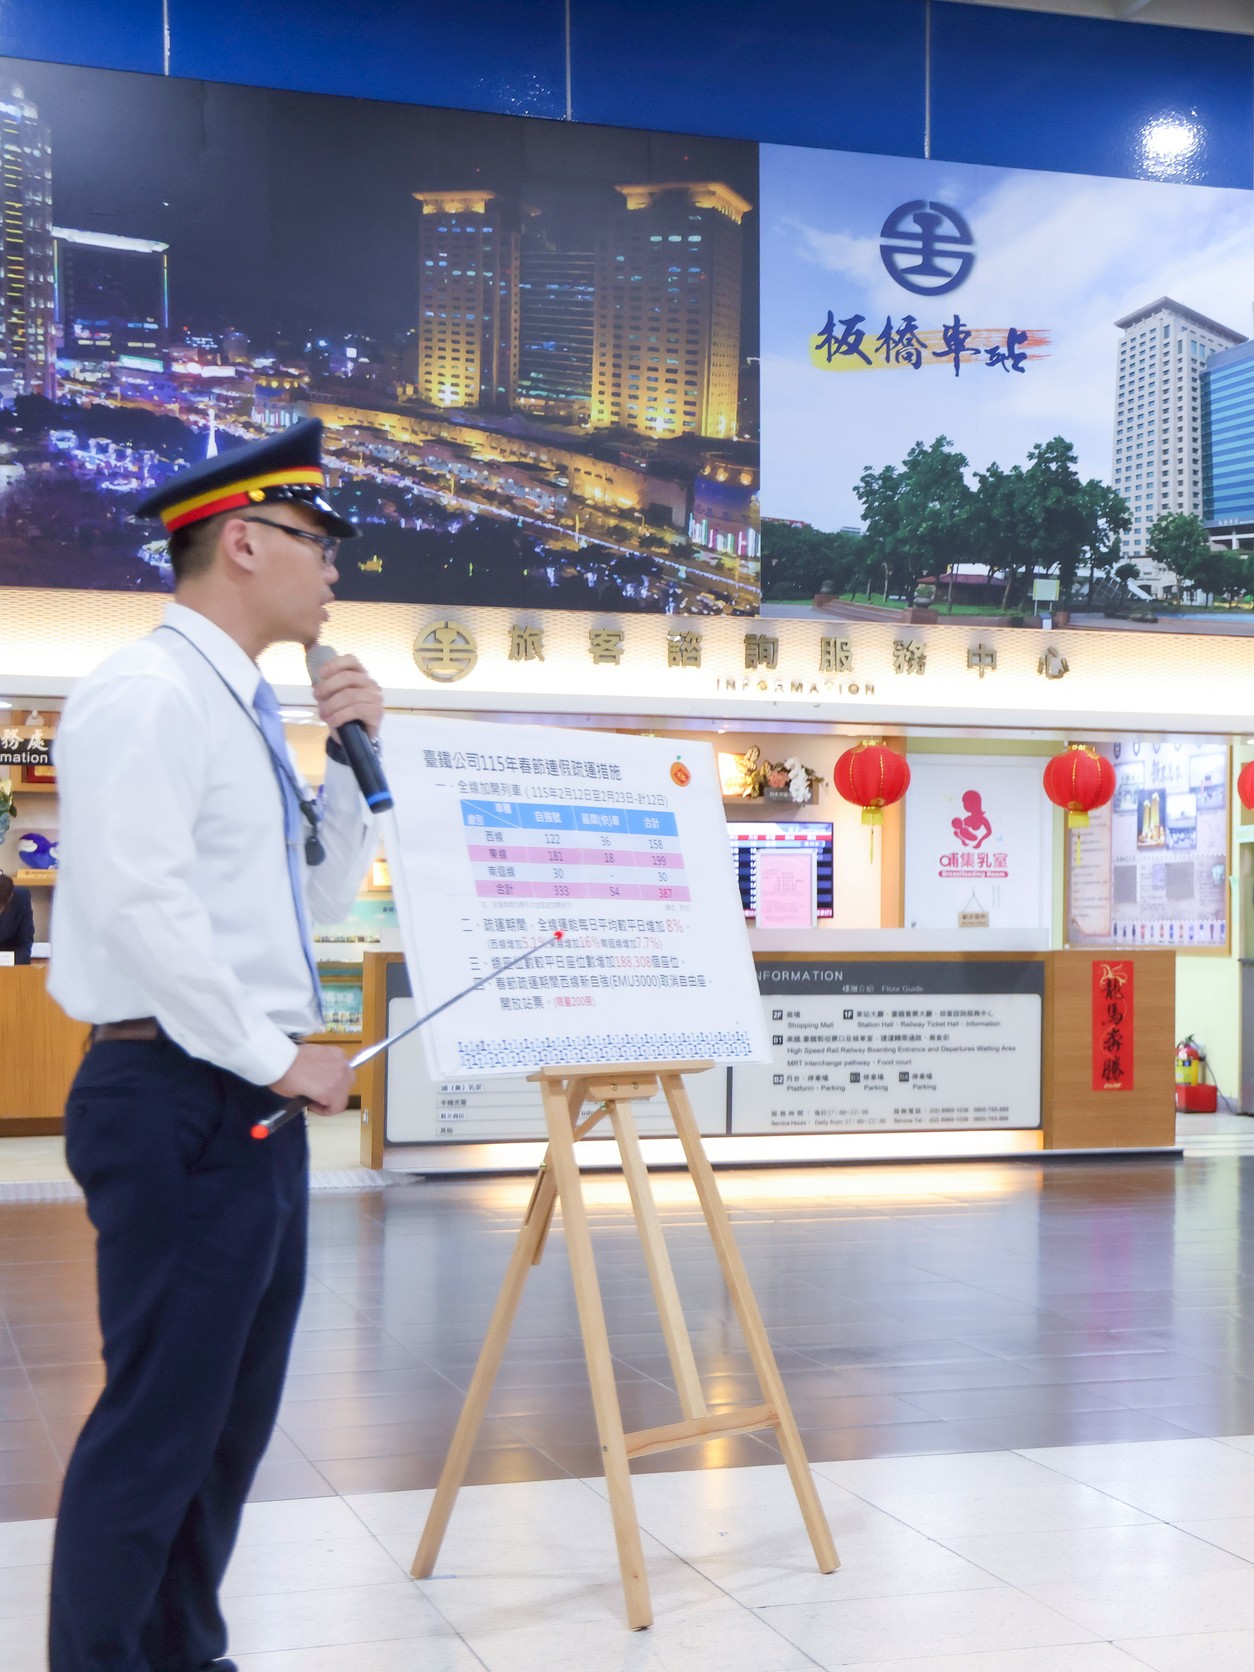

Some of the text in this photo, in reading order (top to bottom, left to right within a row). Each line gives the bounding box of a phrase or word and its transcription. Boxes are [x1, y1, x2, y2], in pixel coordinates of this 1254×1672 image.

[815, 310, 1028, 377] 板橋車站
[508, 624, 1070, 681] 旅客諮詢服務中心
[1, 728, 49, 750] 務處
[422, 749, 622, 781] 臺鐵公司115年春節連假疏運措施
[544, 833, 560, 844] 122
[600, 836, 611, 846] 36
[649, 839, 663, 849] 158
[548, 851, 563, 861] 181
[604, 852, 614, 863] 18
[653, 855, 666, 866] 199
[939, 852, 1008, 868] 哺集乳室
[553, 868, 564, 878] 30
[658, 872, 667, 882] 30
[554, 886, 569, 896] 333
[610, 887, 619, 897] 54
[659, 888, 672, 899] 387
[867, 1046, 896, 1054] Boarding
[941, 1045, 974, 1053] Departures
